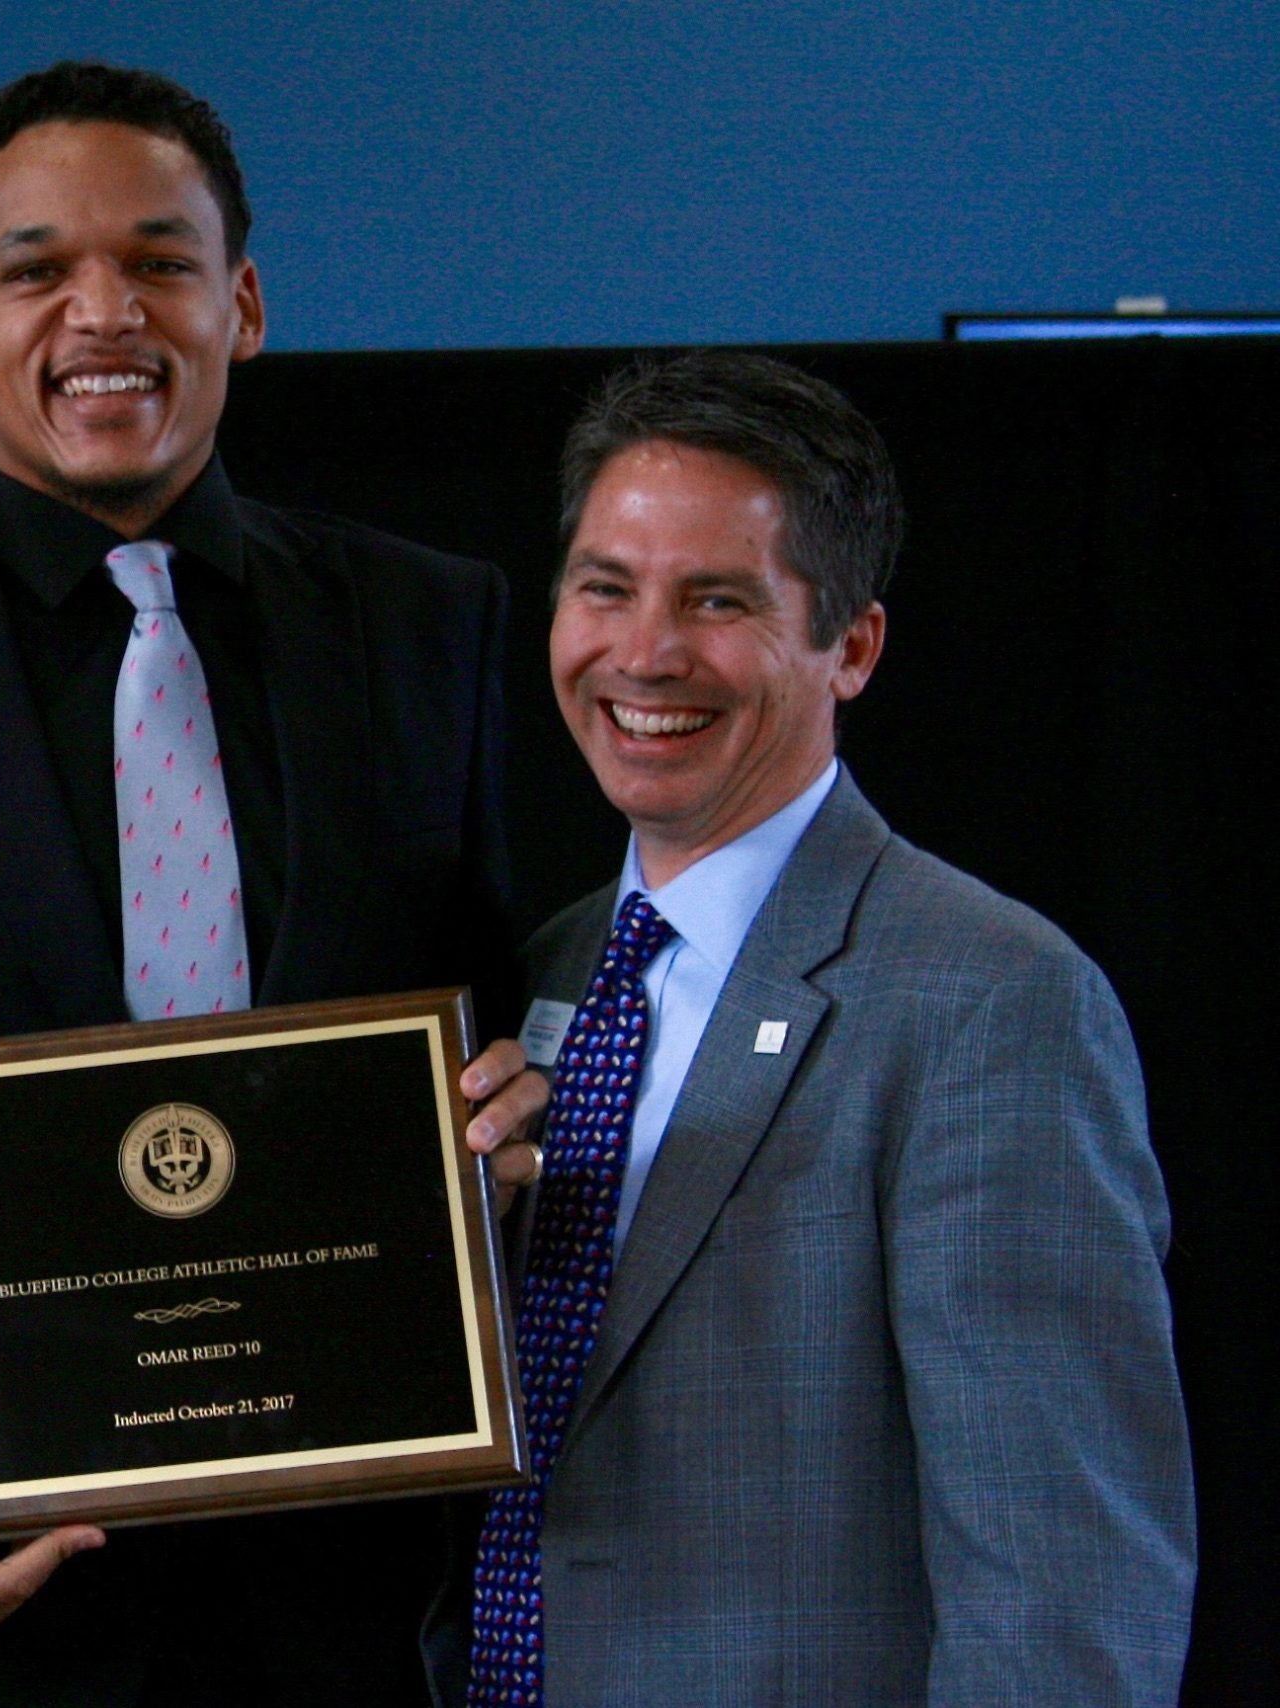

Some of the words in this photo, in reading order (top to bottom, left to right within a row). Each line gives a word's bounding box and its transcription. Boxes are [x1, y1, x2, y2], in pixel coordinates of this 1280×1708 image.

[92, 1266, 170, 1288] COLLEGE
[173, 1256, 256, 1279] ATHLETIC
[259, 1251, 303, 1269] HALL
[306, 1248, 329, 1263] OF
[332, 1243, 379, 1261] FAME
[137, 1349, 190, 1367] OMAR
[192, 1343, 236, 1361] REED
[114, 1406, 175, 1428] Inducted
[178, 1402, 235, 1421] October
[237, 1400, 260, 1415] 21,
[261, 1395, 295, 1412] 2017
